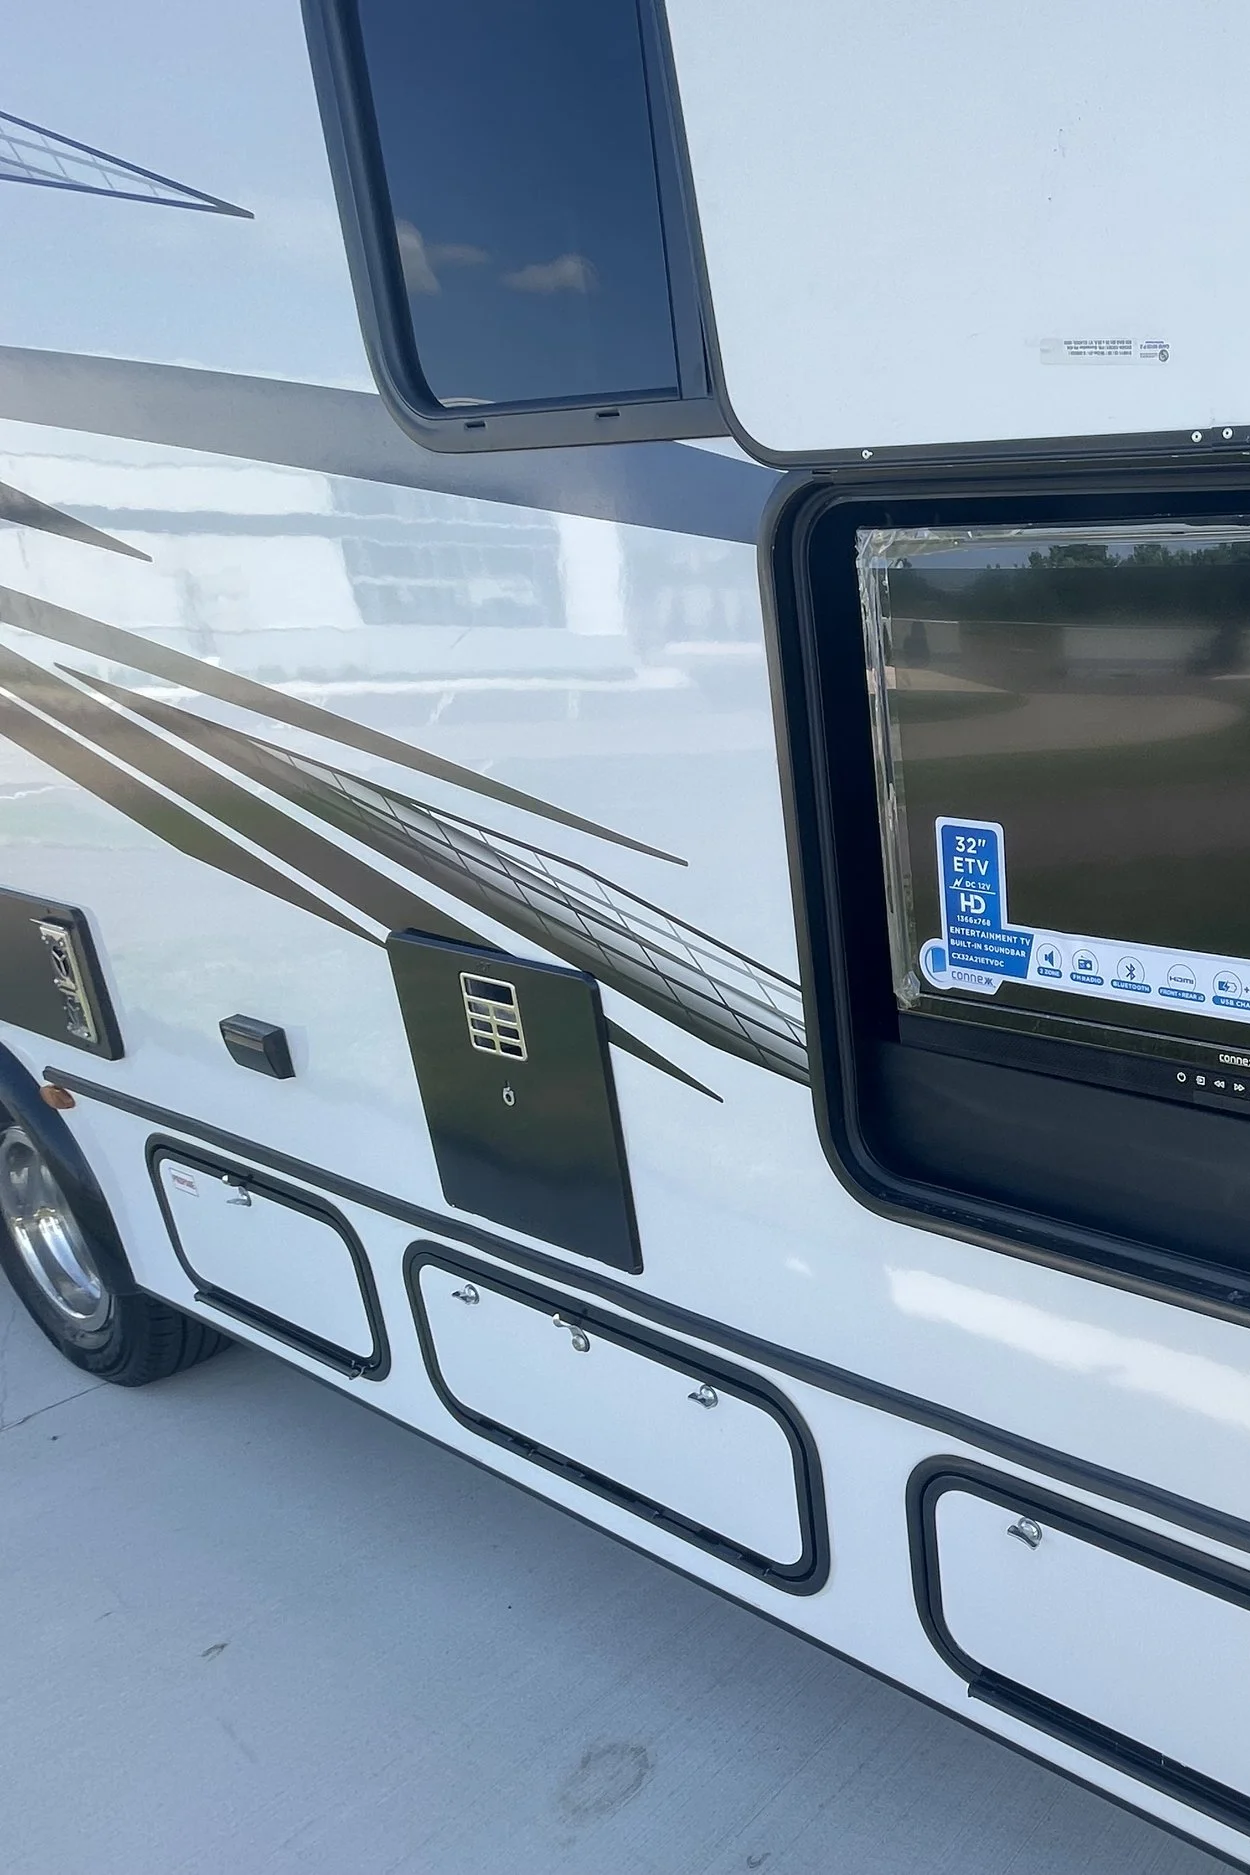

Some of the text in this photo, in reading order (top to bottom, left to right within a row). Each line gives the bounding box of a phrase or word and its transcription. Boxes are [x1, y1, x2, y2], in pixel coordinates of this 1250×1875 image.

[955, 836, 986, 854] 32"
[953, 856, 989, 876] ETV
[965, 880, 991, 891] DC 12V
[960, 892, 986, 914] HD
[956, 915, 991, 927] 1366x768
[949, 926, 1031, 946] ENTERTAINMENT TV
[950, 939, 1027, 958] BUILT-IN SOUNDBAR
[951, 952, 1005, 967] CX32A21ETVDC
[1113, 981, 1150, 992] BLUETOOTH
[1169, 975, 1194, 985] HDMI
[1220, 998, 1234, 1007] USB
